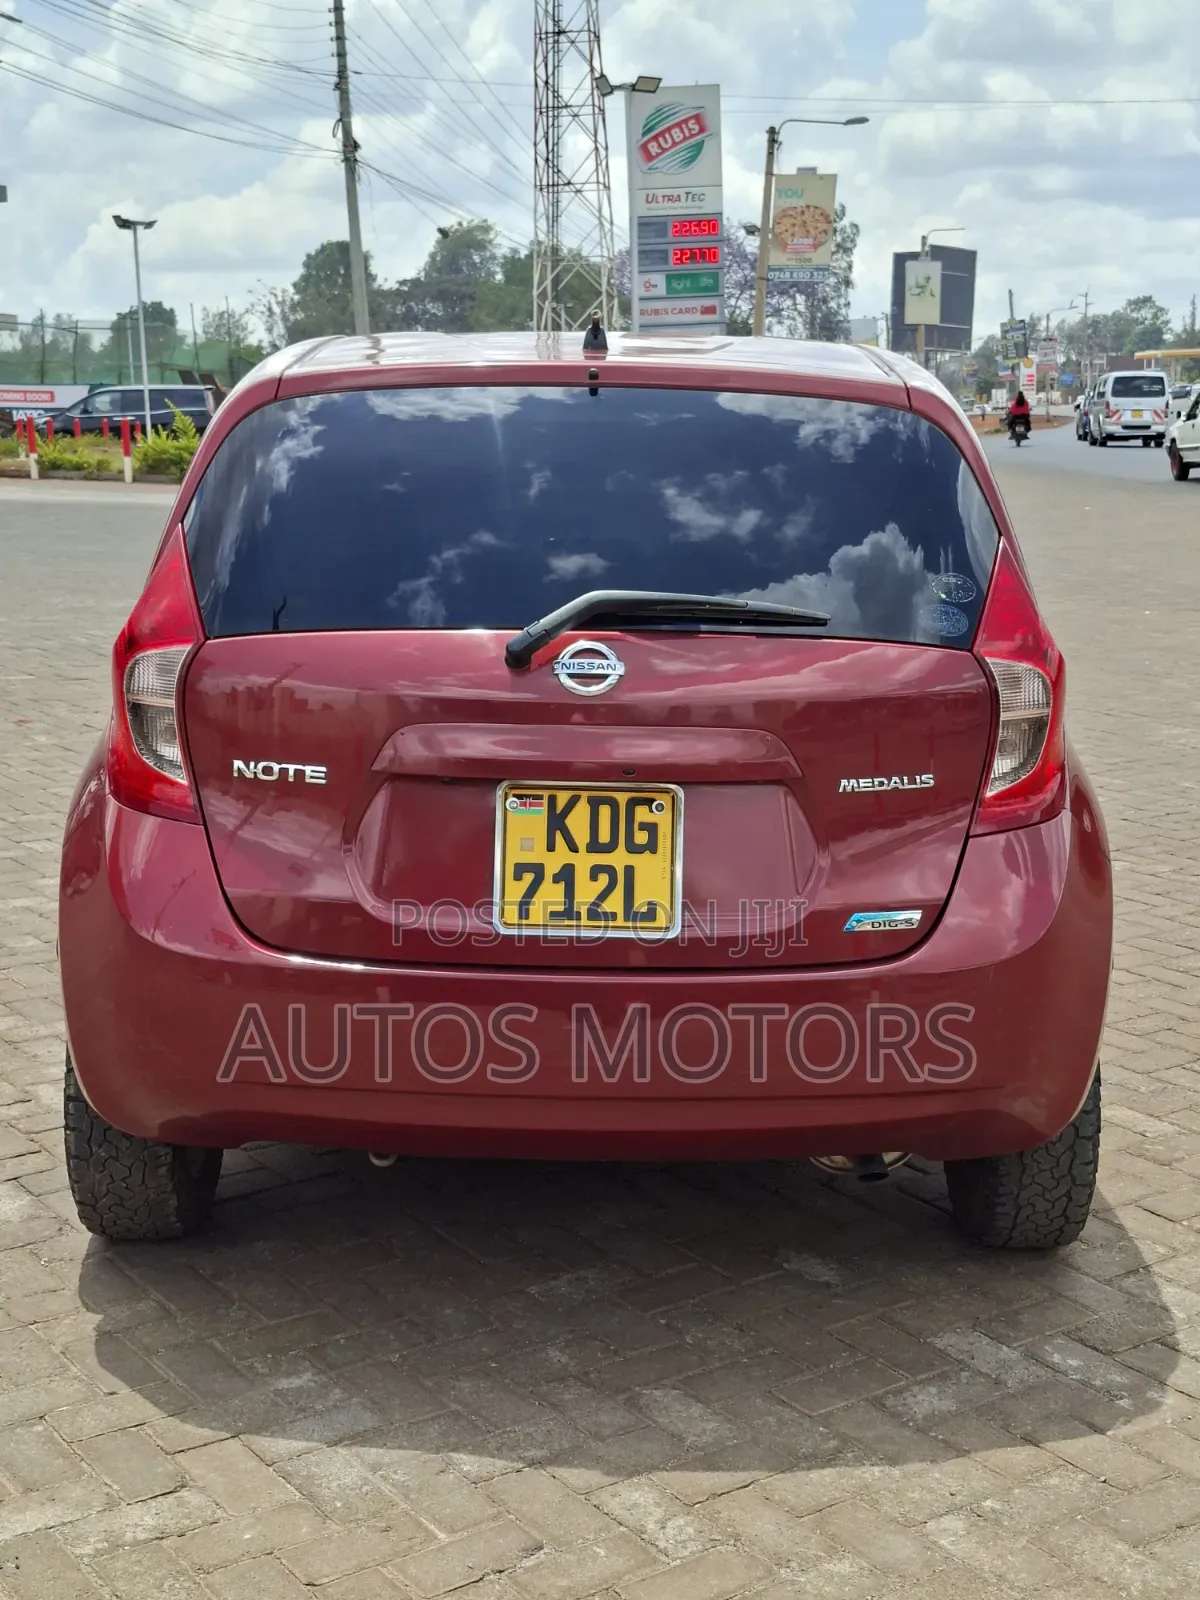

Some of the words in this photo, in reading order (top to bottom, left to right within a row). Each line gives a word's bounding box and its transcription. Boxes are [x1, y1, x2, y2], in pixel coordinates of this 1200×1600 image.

[647, 119, 700, 156] RUBIS
[684, 191, 706, 203] TEC
[775, 187, 804, 199] YOU
[671, 307, 698, 315] CARD
[561, 662, 617, 671] NISSAN
[232, 759, 327, 784] NOTE
[838, 774, 935, 792] MEDALIS
[546, 794, 660, 855] KDG
[512, 862, 658, 923] 712L
[871, 920, 914, 929] DIG-S
